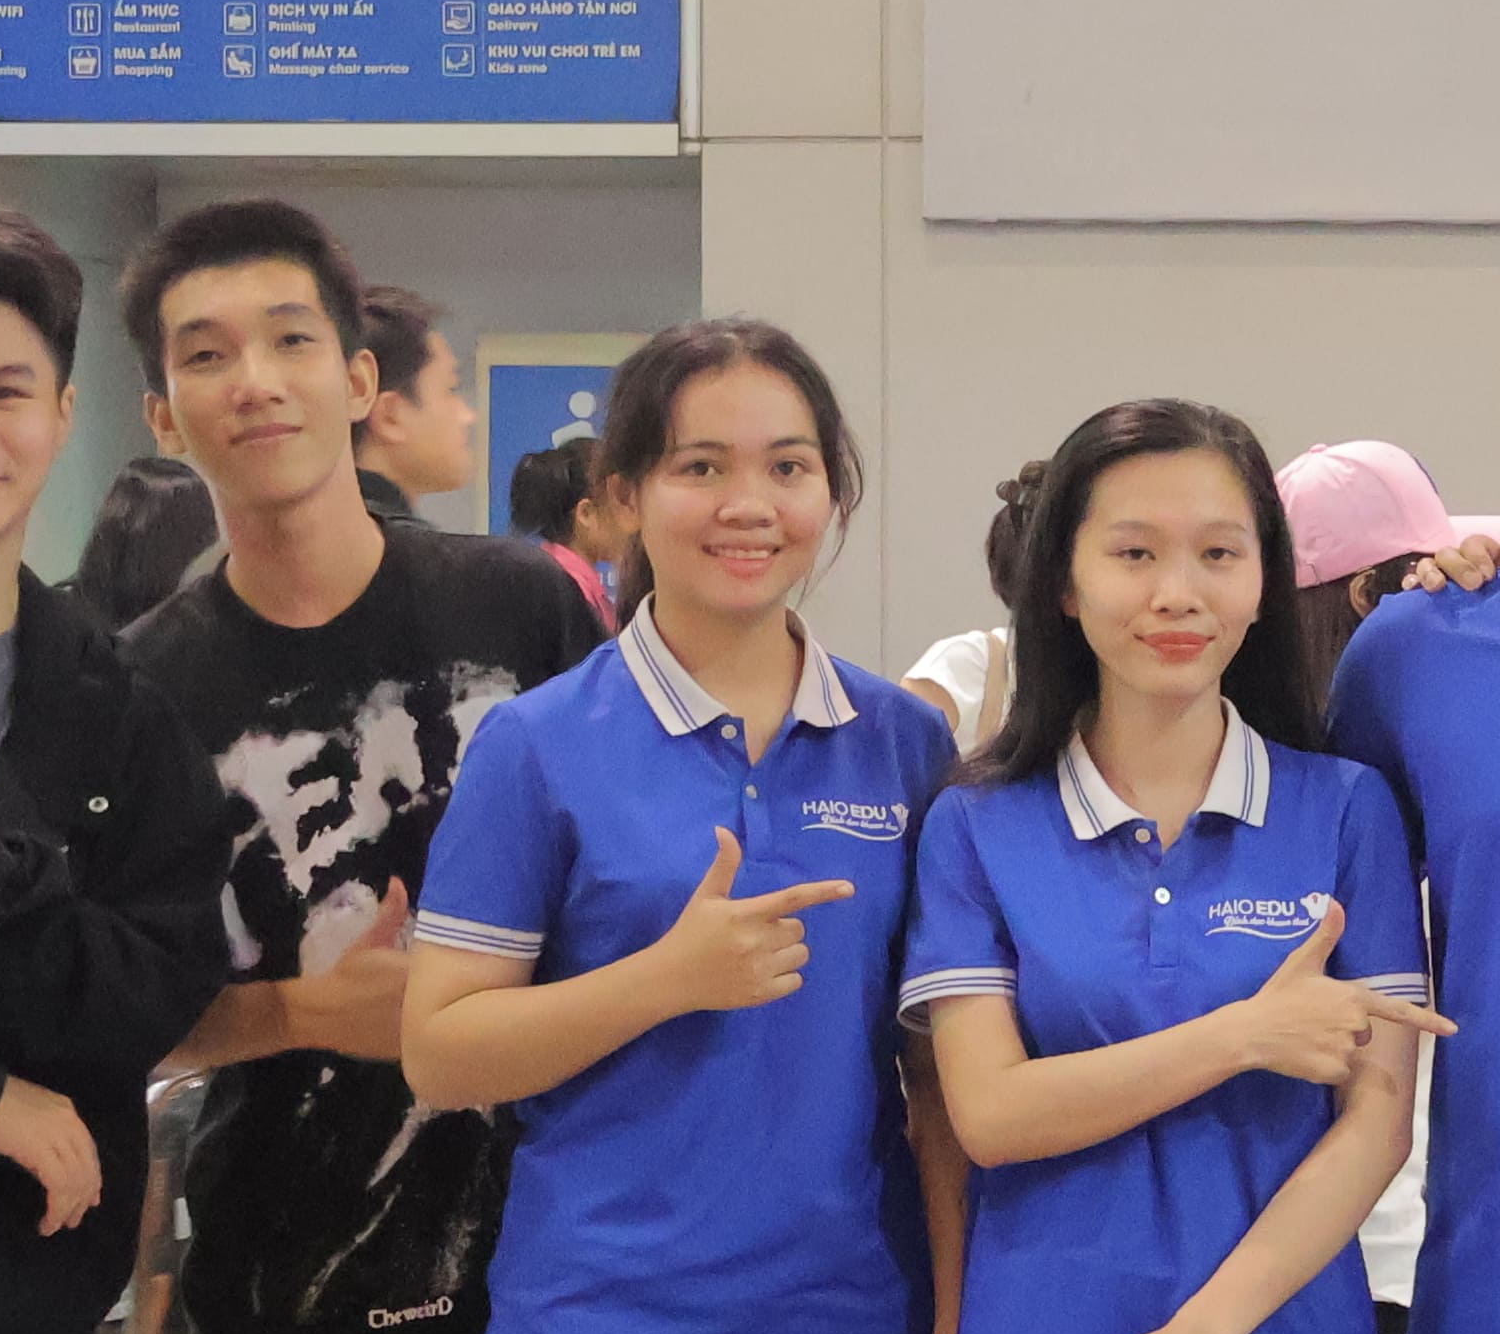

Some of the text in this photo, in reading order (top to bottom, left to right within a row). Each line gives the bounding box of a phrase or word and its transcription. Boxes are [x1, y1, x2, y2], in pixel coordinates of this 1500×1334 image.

[268, 2, 305, 19] DỊCH
[309, 2, 329, 19] VỤ
[333, 3, 348, 16] IN
[487, 1, 526, 16] GIAO
[530, 0, 574, 16] HÀNG
[113, 47, 146, 60] MUA
[337, 46, 358, 59] XA
[488, 44, 518, 58] KHU
[522, 44, 546, 58] VUI
[550, 43, 589, 58] CHƠI
[620, 45, 641, 58] EM
[802, 799, 886, 820] HAIO EDU
[1209, 899, 1295, 919] HAIO EDU
